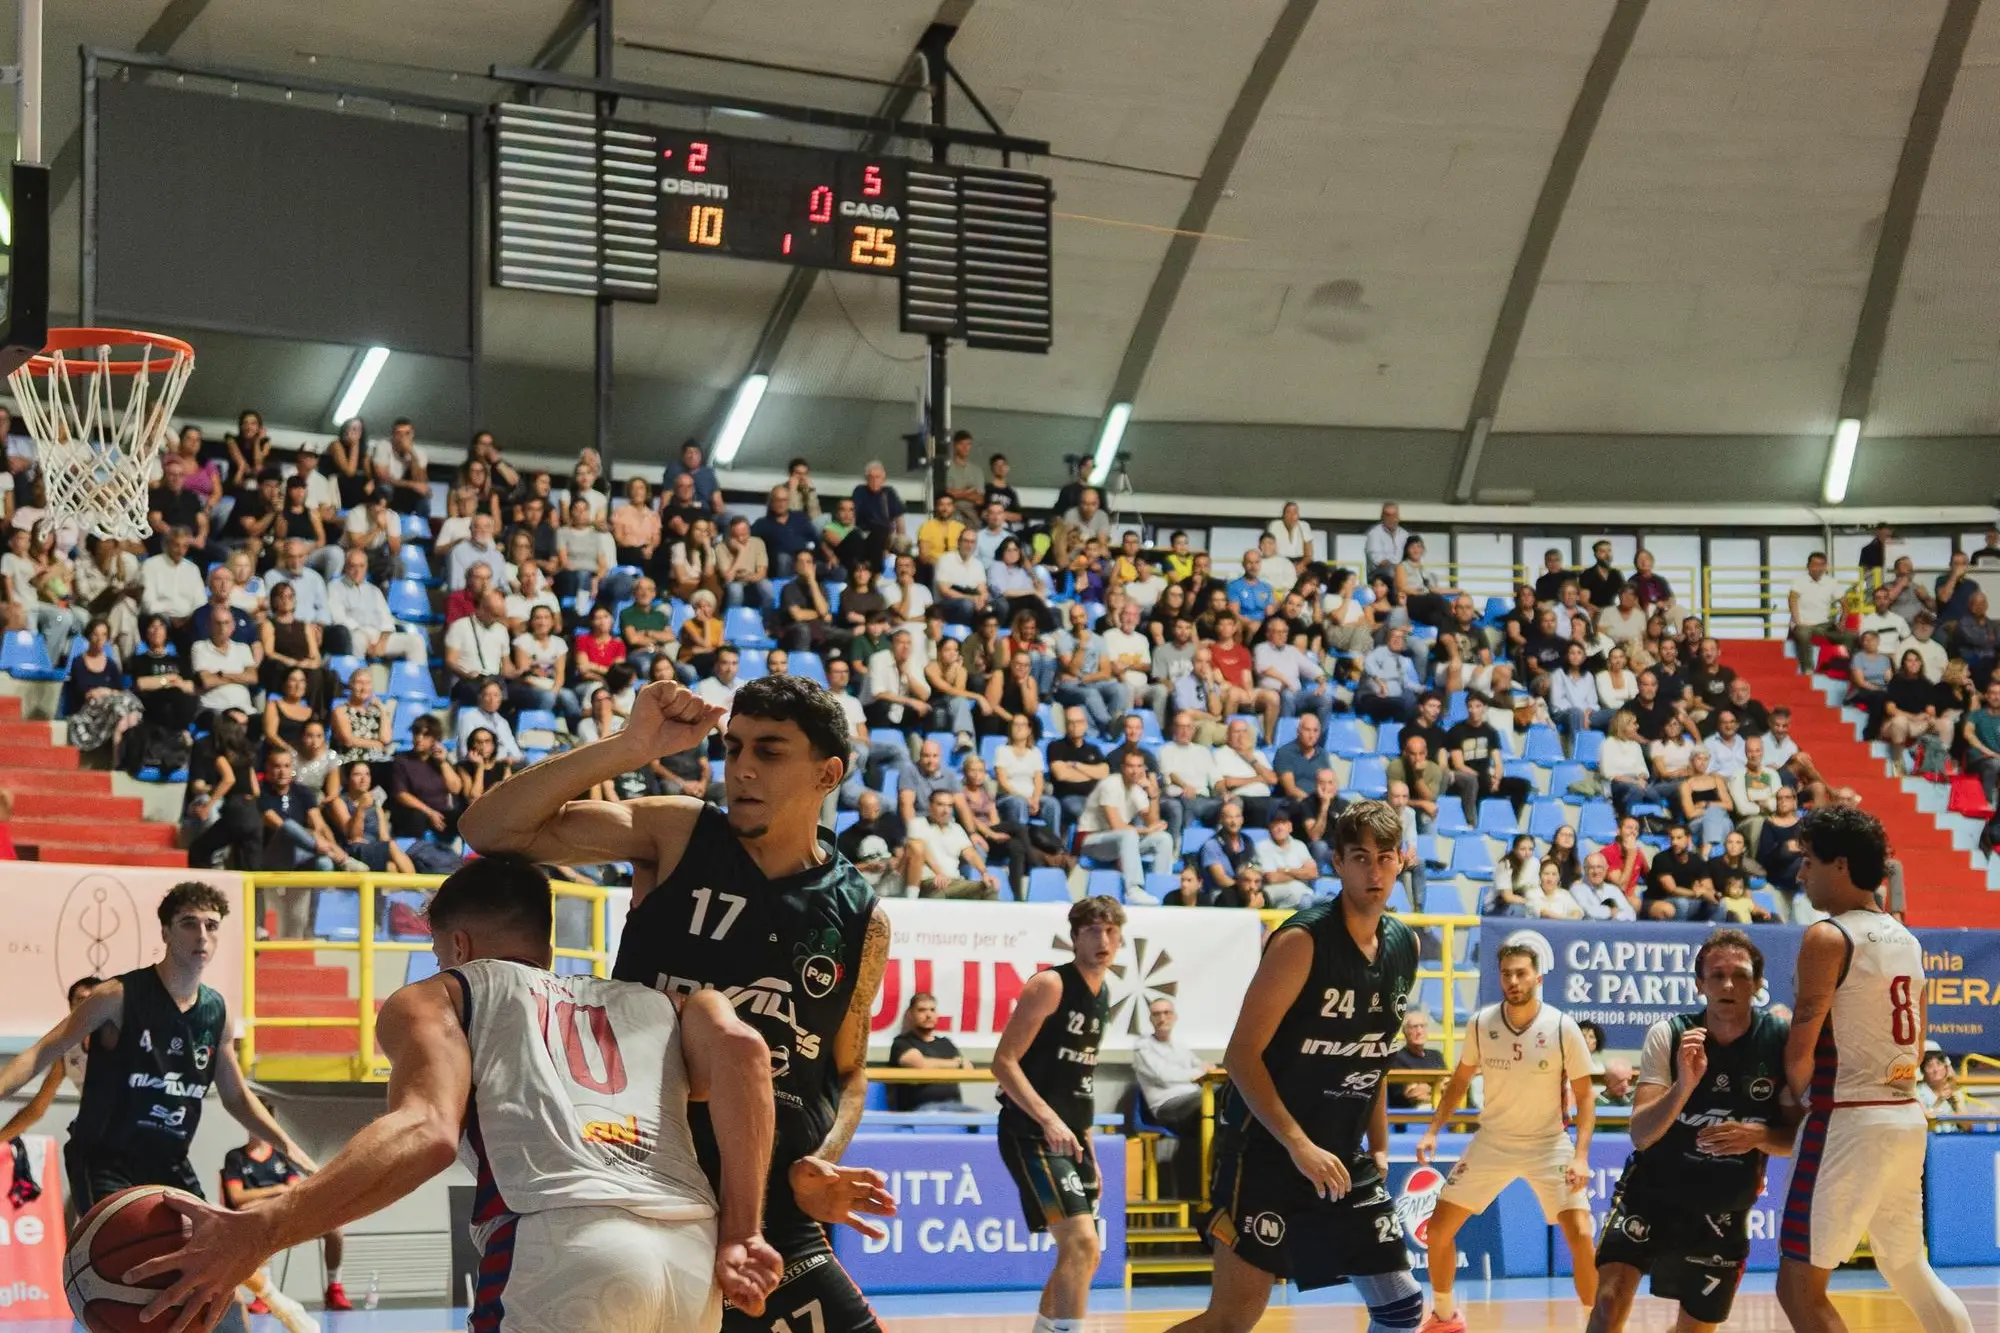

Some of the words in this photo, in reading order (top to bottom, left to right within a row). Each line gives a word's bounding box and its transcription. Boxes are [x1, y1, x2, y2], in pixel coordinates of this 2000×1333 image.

[688, 142, 708, 173] 2
[660, 177, 729, 200] OSPITI
[863, 165, 882, 196] 5
[688, 205, 724, 246] 10
[839, 200, 900, 222] CASA
[851, 225, 896, 267] 25
[688, 887, 747, 941] 17
[1321, 988, 1356, 1019] 24
[1566, 973, 1593, 1004] &
[1600, 974, 1770, 1008] PARTNS
[1568, 1010, 1625, 1025] SUPERIOR
[1890, 975, 1916, 1046] 8
[139, 1029, 153, 1053] 4
[1928, 1023, 1984, 1035] PARTNERS
[1513, 1043, 1522, 1061] 5
[862, 1218, 903, 1254] DI
[917, 1218, 1107, 1254] CAGLII
[782, 1253, 828, 1283] SYSTEMS
[1702, 1273, 1721, 1297] 7
